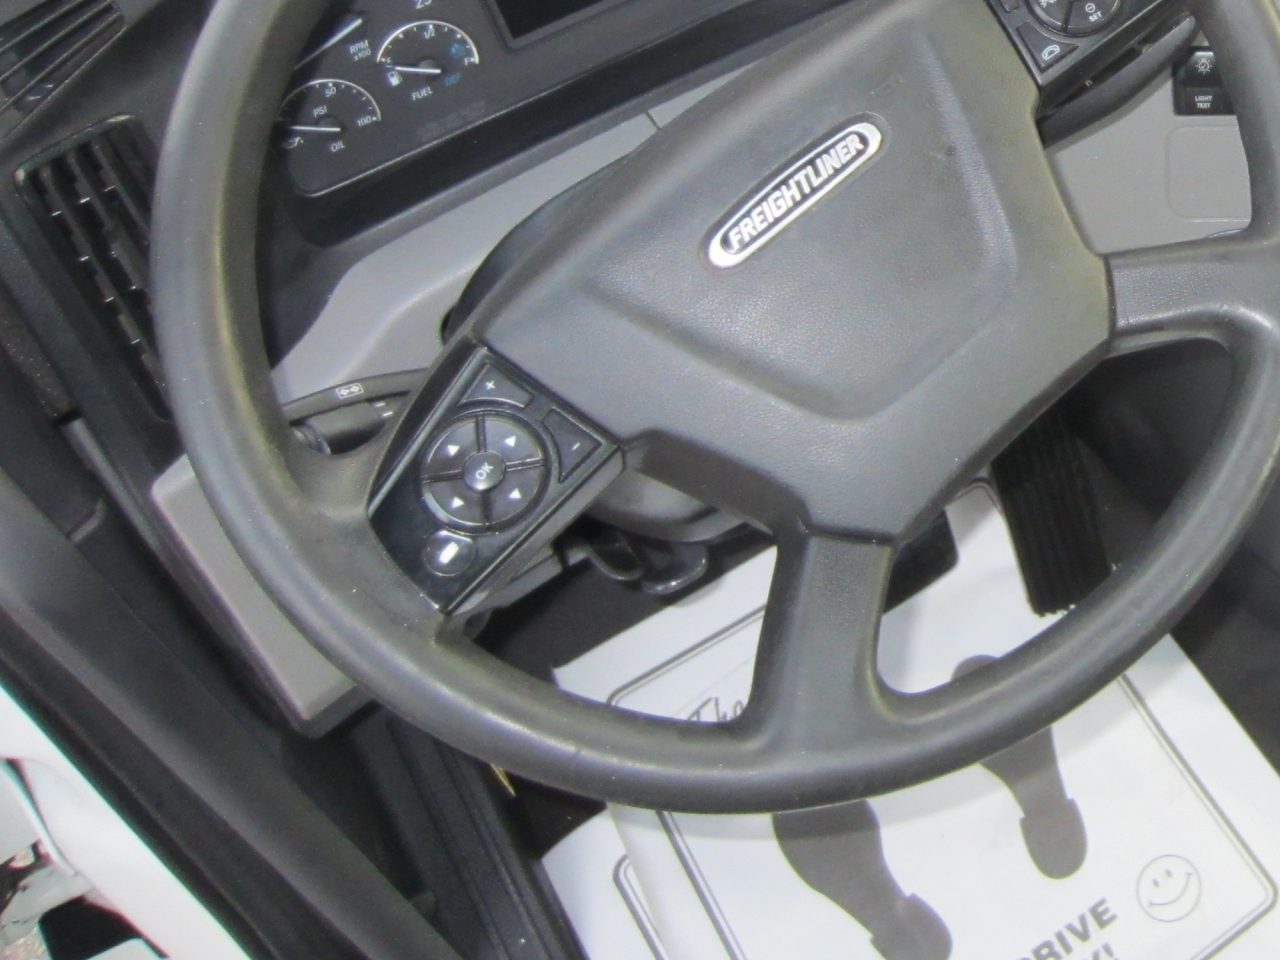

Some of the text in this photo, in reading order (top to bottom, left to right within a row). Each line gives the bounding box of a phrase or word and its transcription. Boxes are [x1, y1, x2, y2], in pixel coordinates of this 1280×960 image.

[1089, 10, 1102, 22] SET
[349, 39, 369, 55] RPM
[325, 86, 337, 98] 50
[411, 85, 433, 101] FUEL
[313, 105, 327, 118] PSI
[357, 115, 372, 127] 100
[331, 140, 345, 152] OIL
[728, 133, 864, 253] FREIGHTLINER
[475, 461, 494, 480] OK
[1018, 897, 1118, 960] RIVE
